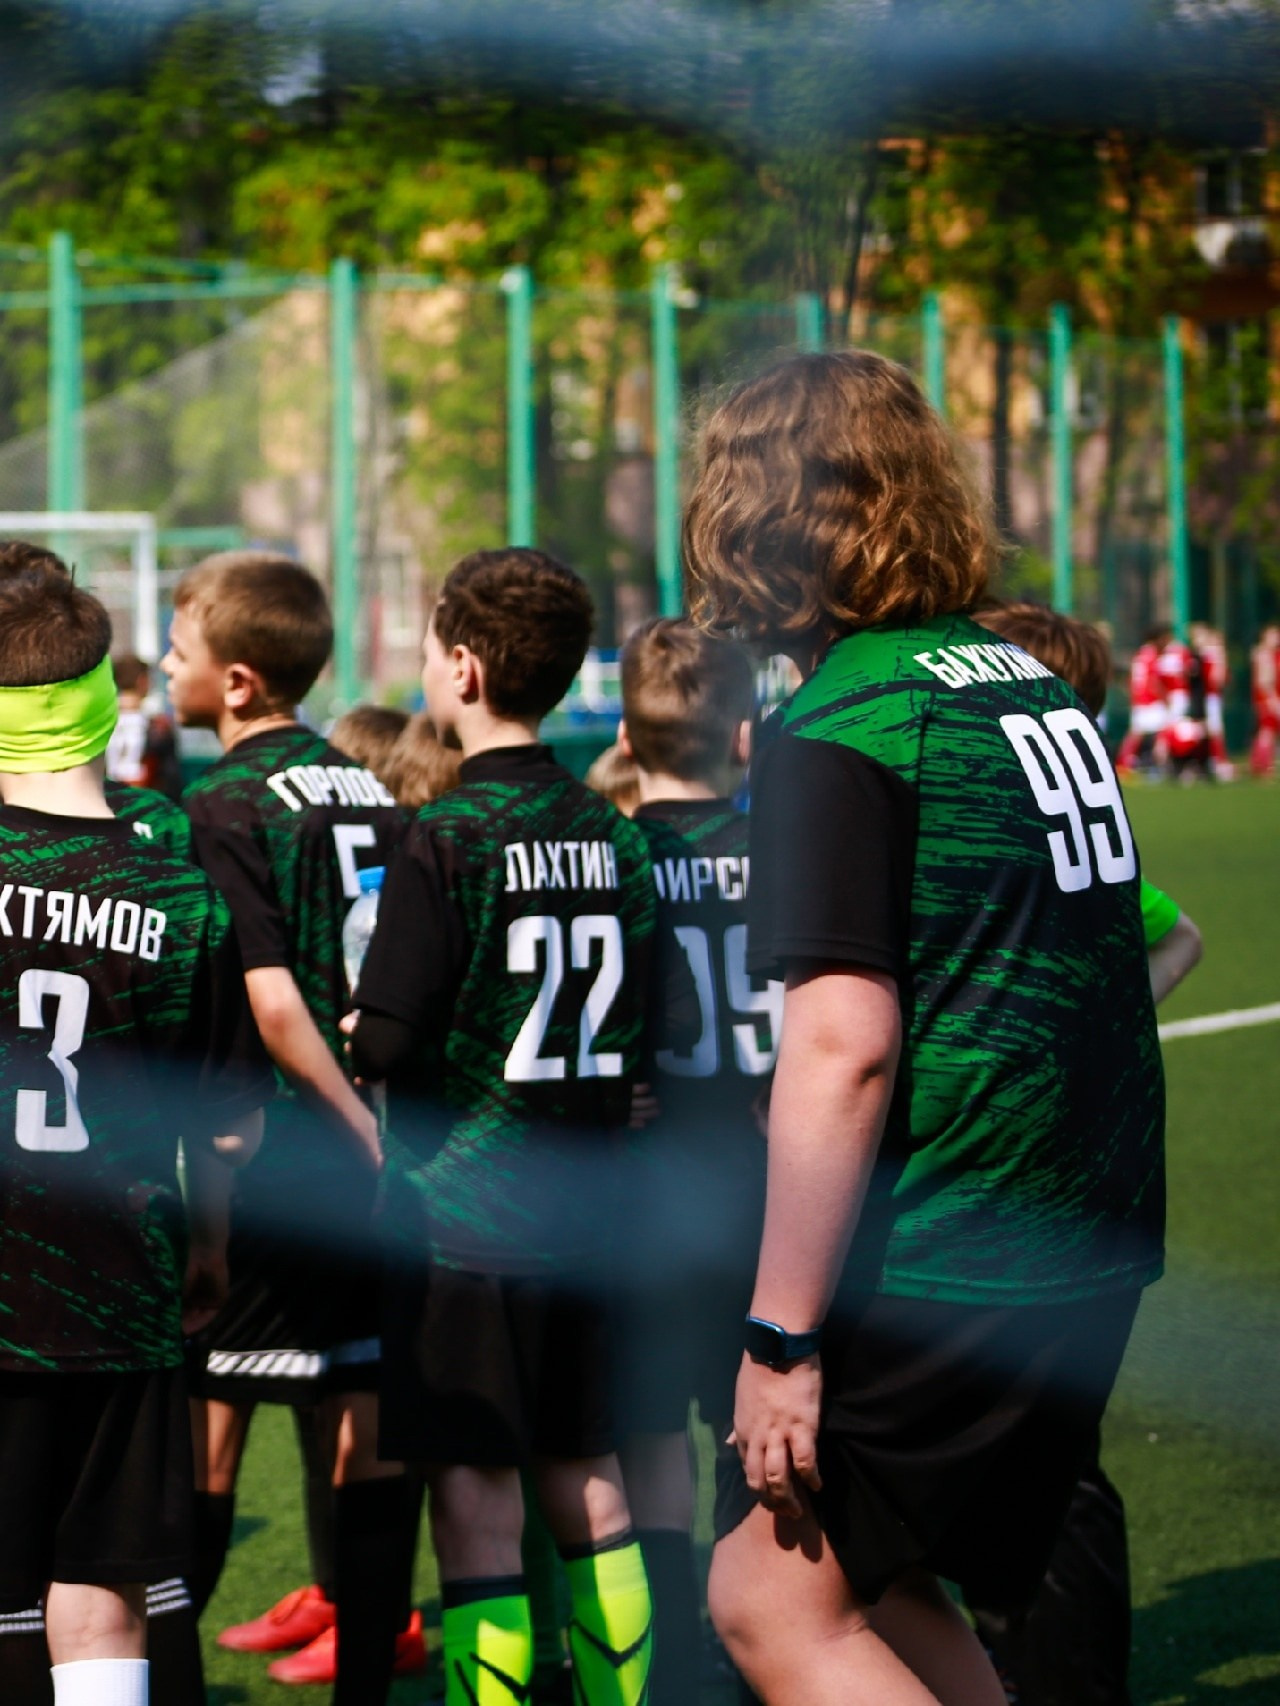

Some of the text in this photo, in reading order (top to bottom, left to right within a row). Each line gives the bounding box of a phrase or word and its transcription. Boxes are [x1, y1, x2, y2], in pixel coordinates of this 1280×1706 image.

[504, 840, 618, 892] ЛАХТИН
[652, 855, 751, 903] ИРС
[1000, 707, 1135, 893] 99
[15, 968, 90, 1152] 3
[503, 914, 624, 1082] 22
